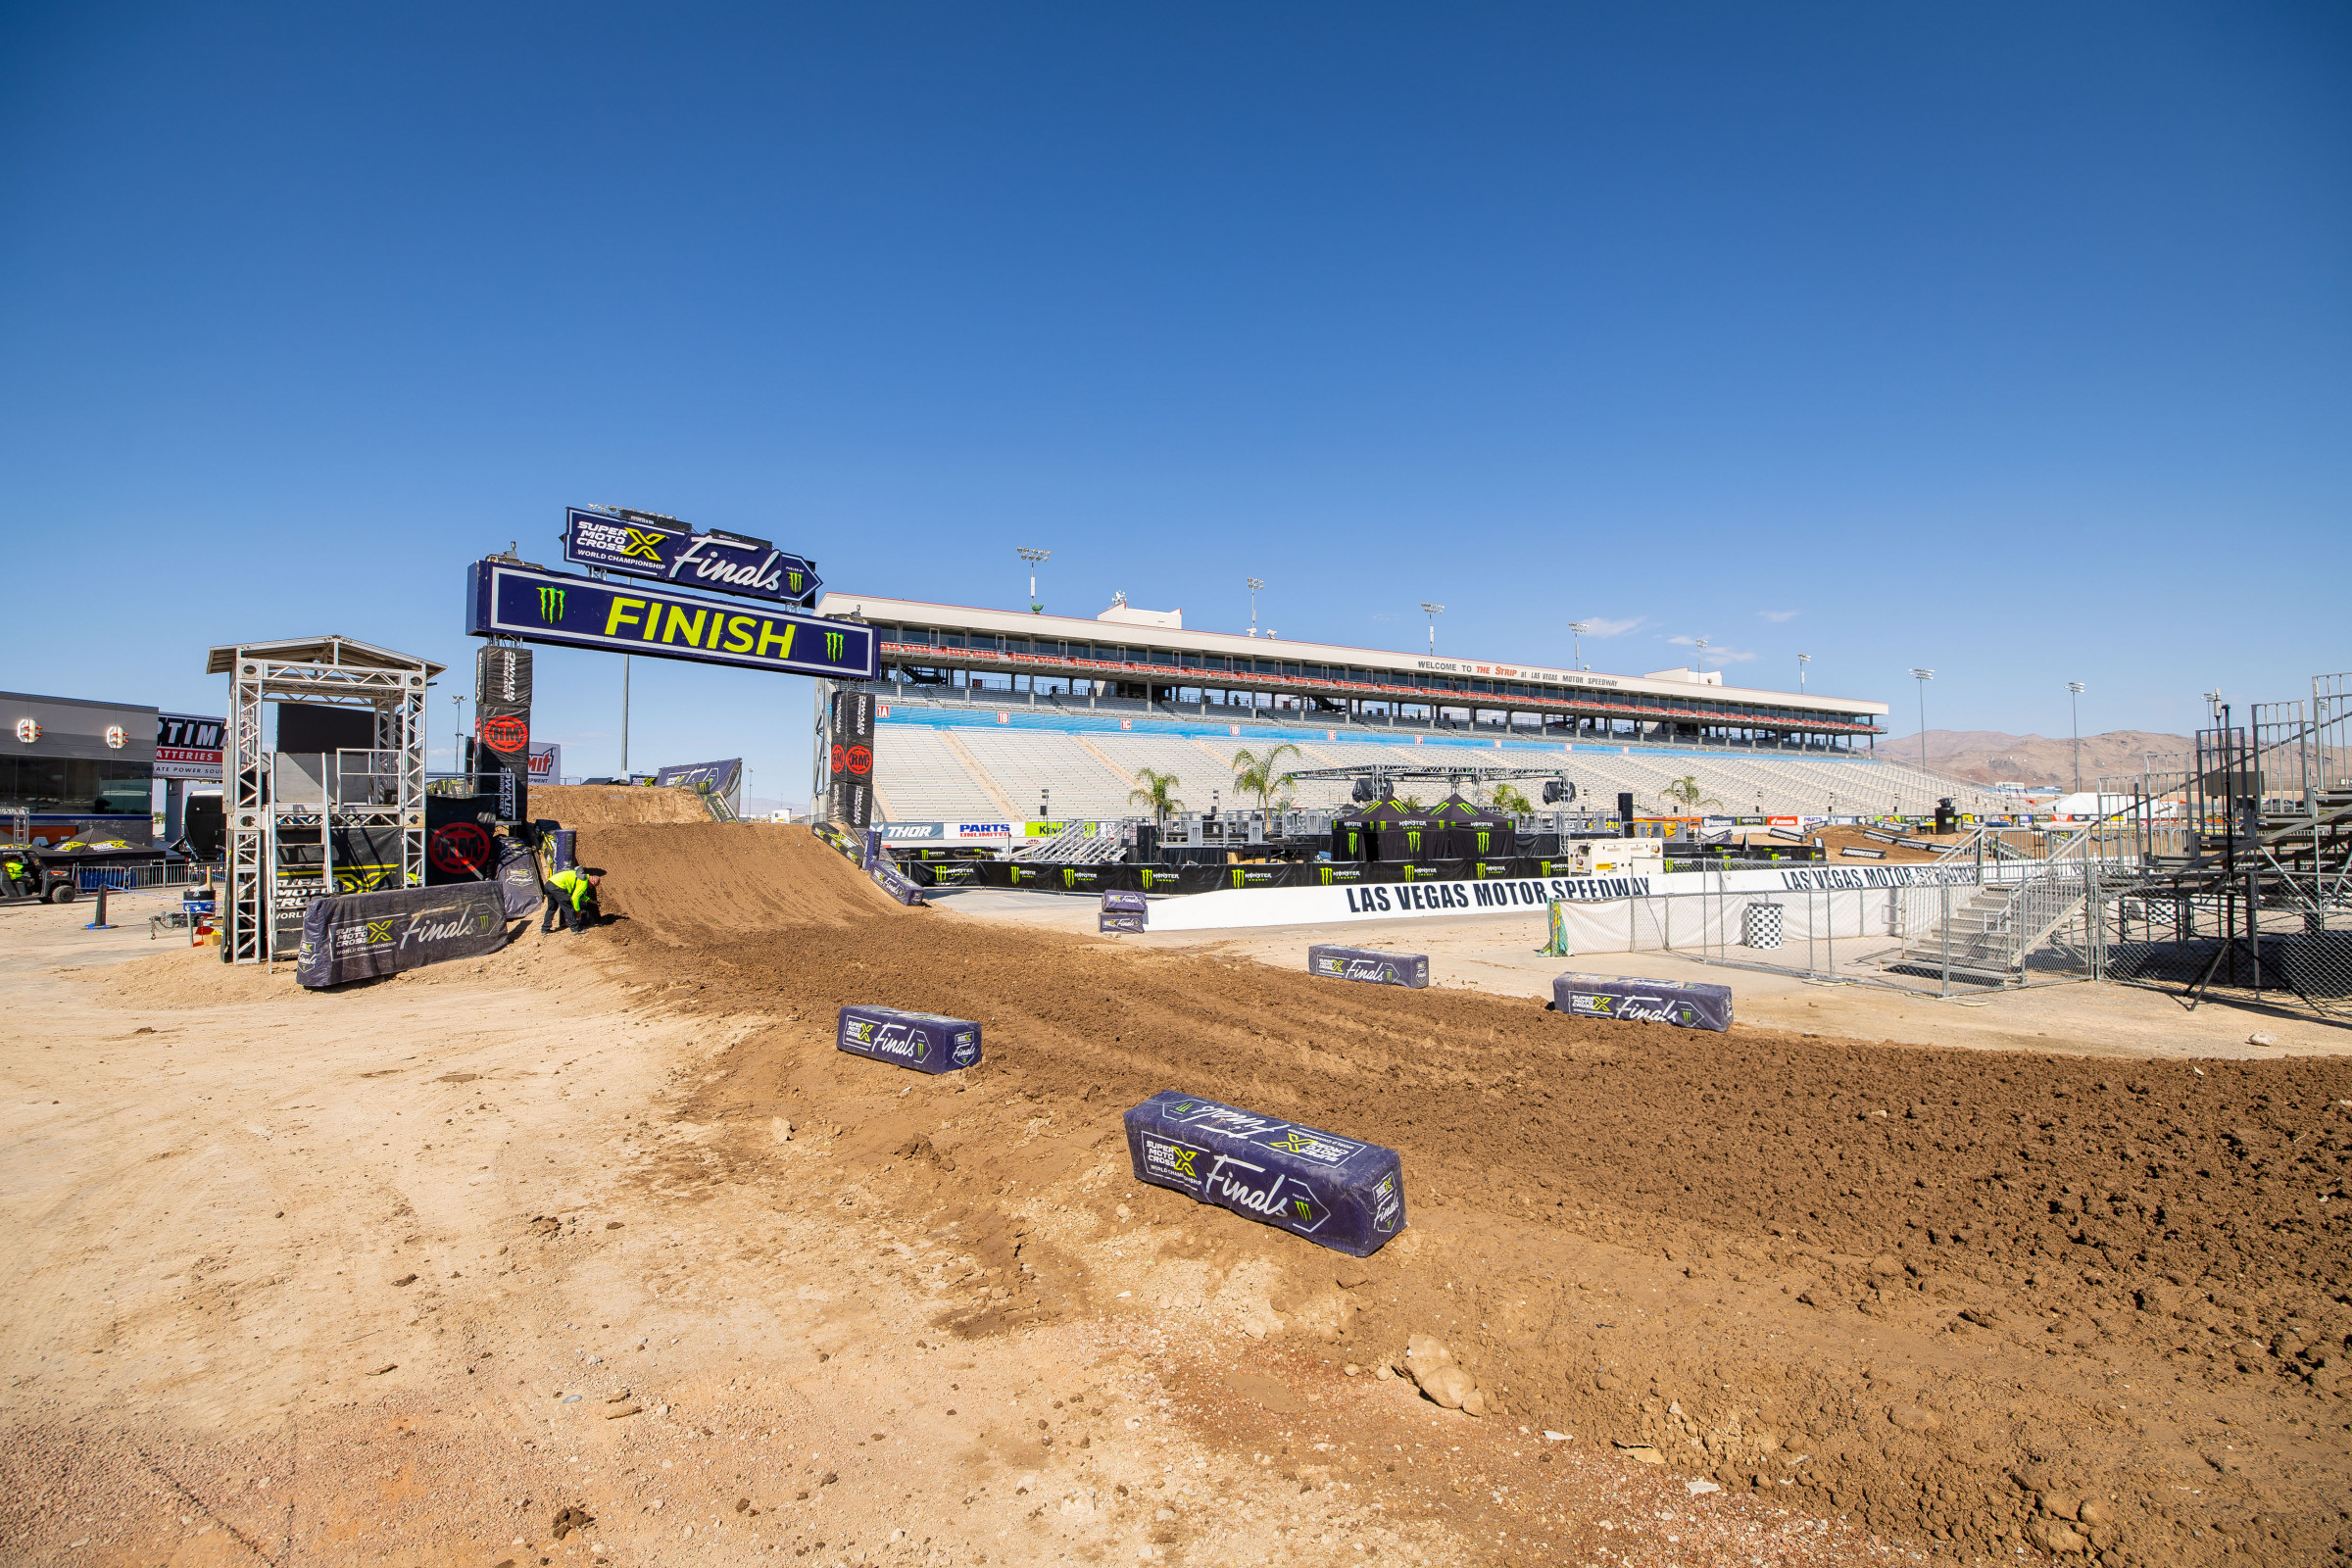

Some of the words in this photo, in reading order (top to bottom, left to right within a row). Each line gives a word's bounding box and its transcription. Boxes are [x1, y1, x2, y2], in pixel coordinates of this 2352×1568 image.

[577, 520, 628, 537] SUPER
[576, 537, 627, 553] CROSS
[580, 529, 626, 545] MOTO
[577, 549, 607, 560] WORLD
[608, 555, 666, 570] CHAMPIONSHIP
[669, 534, 782, 592] Finals
[604, 596, 797, 659] FINISH
[1418, 661, 1457, 671] WELCOME
[1476, 665, 1491, 675] THE
[1531, 671, 1541, 680] LAS
[1542, 673, 1558, 682] VEGAS
[1562, 674, 1584, 684] MOTOR
[1588, 677, 1619, 687] SPEEDWAY
[877, 707, 888, 717] 1A
[999, 712, 1008, 723] 1B
[1121, 720, 1131, 729] 1C
[887, 824, 933, 838] THOR
[1781, 870, 1811, 891] LAS
[1346, 887, 1391, 913] LAS
[1394, 883, 1470, 910] VEGAS
[1473, 879, 1548, 907] MOTOR
[335, 925, 368, 935] SUPER
[399, 903, 475, 950] Finals
[335, 938, 368, 949] CROSS
[337, 932, 368, 942] MOTO
[1345, 958, 1385, 982] Finals
[1616, 995, 1679, 1023] Finals
[871, 1022, 915, 1057] Finals
[1146, 1140, 1174, 1154] SUPER
[1149, 1148, 1175, 1161] MOTO
[1148, 1154, 1176, 1168] CROSS
[1150, 1164, 1168, 1173] WORLD
[1205, 1154, 1289, 1218] Finals
